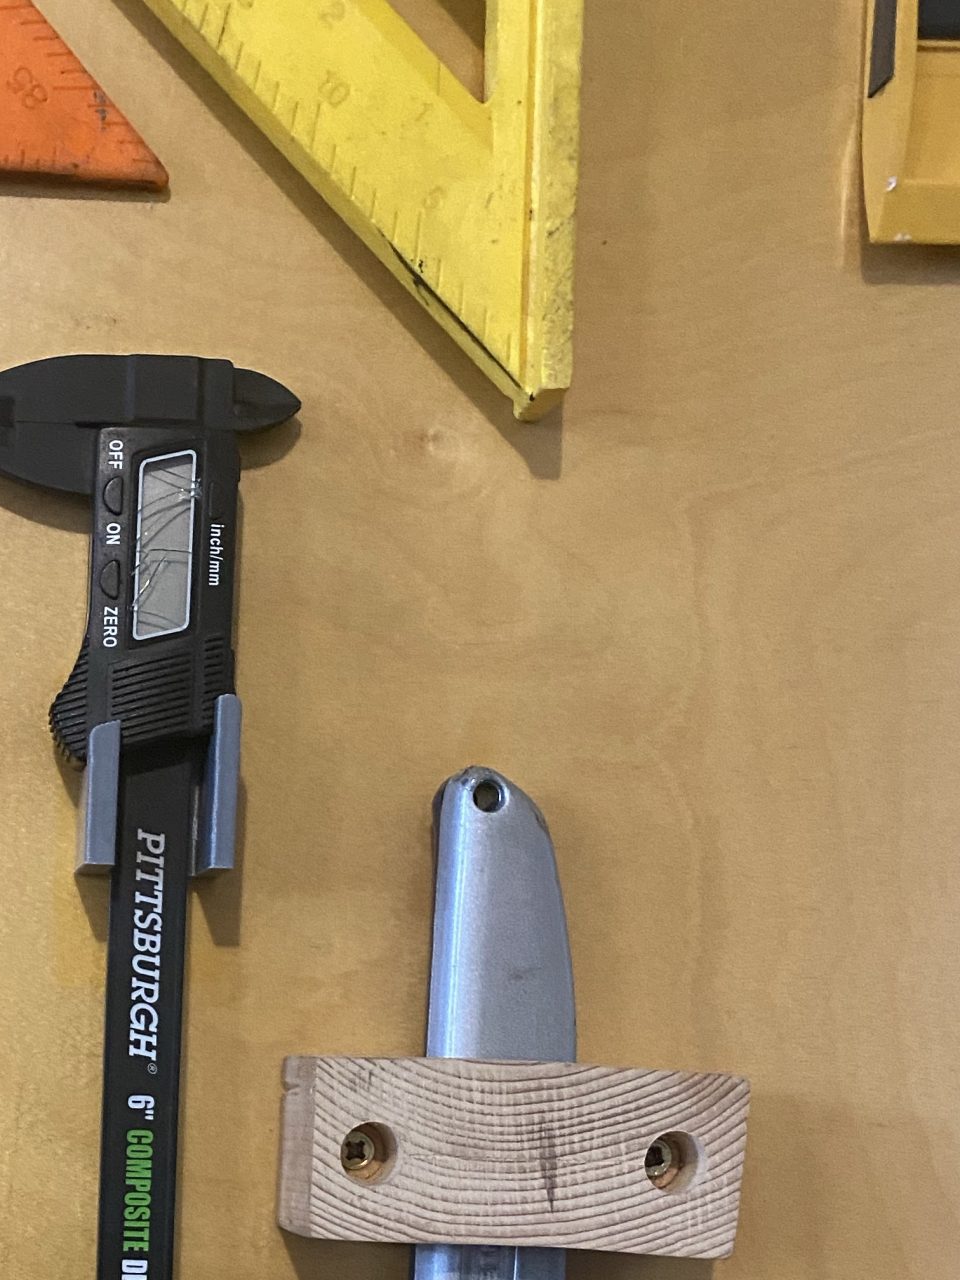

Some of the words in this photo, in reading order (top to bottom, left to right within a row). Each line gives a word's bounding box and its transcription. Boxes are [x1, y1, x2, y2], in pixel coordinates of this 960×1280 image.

[108, 440, 124, 470] OFF
[106, 522, 121, 545] ON
[208, 523, 225, 586] inch/mm
[102, 606, 118, 648] ZERO
[128, 828, 166, 1061] PITTSBURGH
[127, 1094, 156, 1121] 6"
[123, 1129, 154, 1252] COMPOSITE
